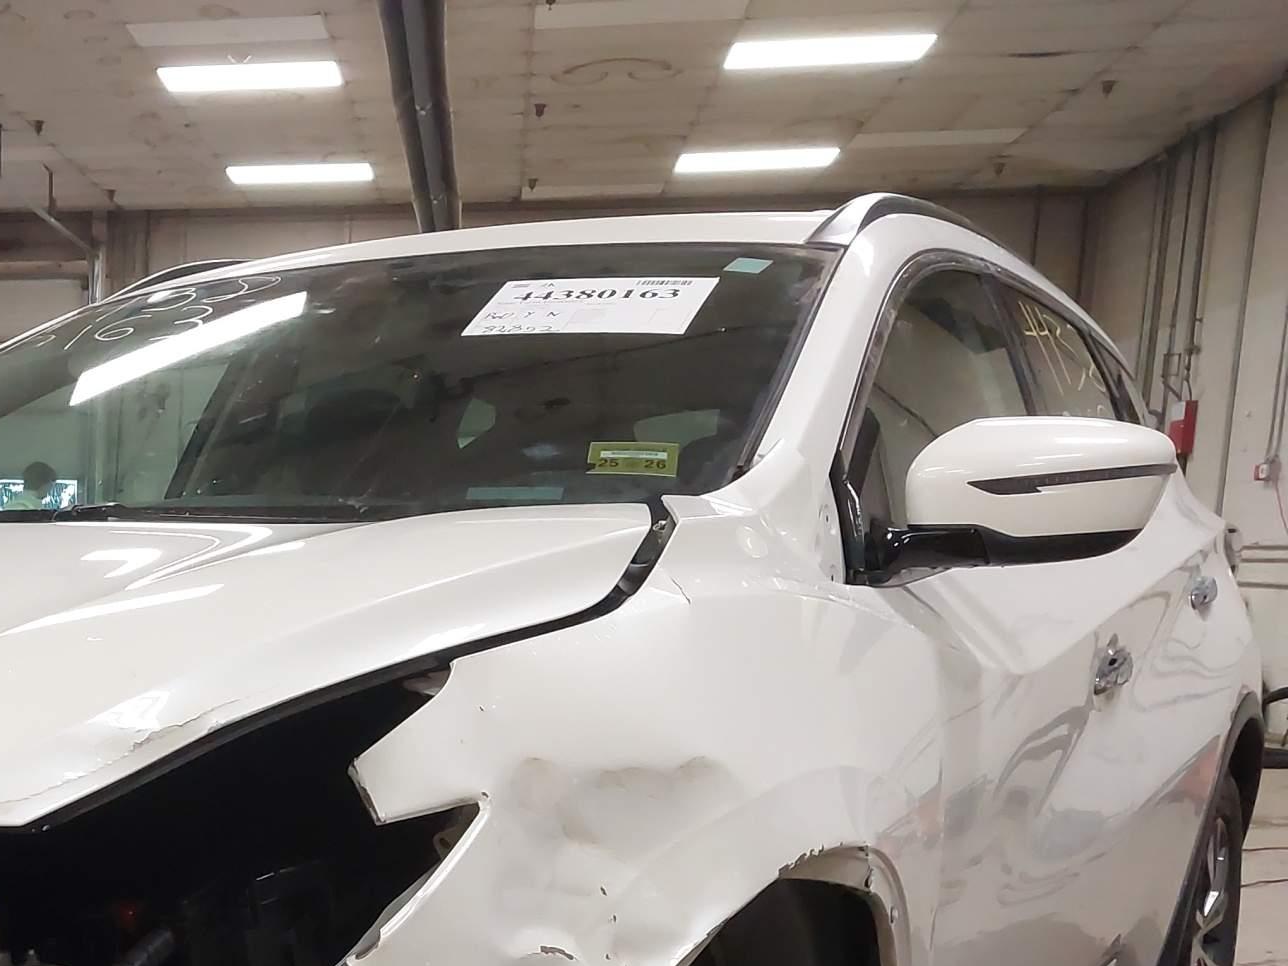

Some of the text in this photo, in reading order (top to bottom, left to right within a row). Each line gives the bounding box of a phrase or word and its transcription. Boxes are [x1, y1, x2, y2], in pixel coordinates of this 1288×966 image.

[514, 289, 680, 300] 44380163
[598, 459, 666, 470] 25 26
